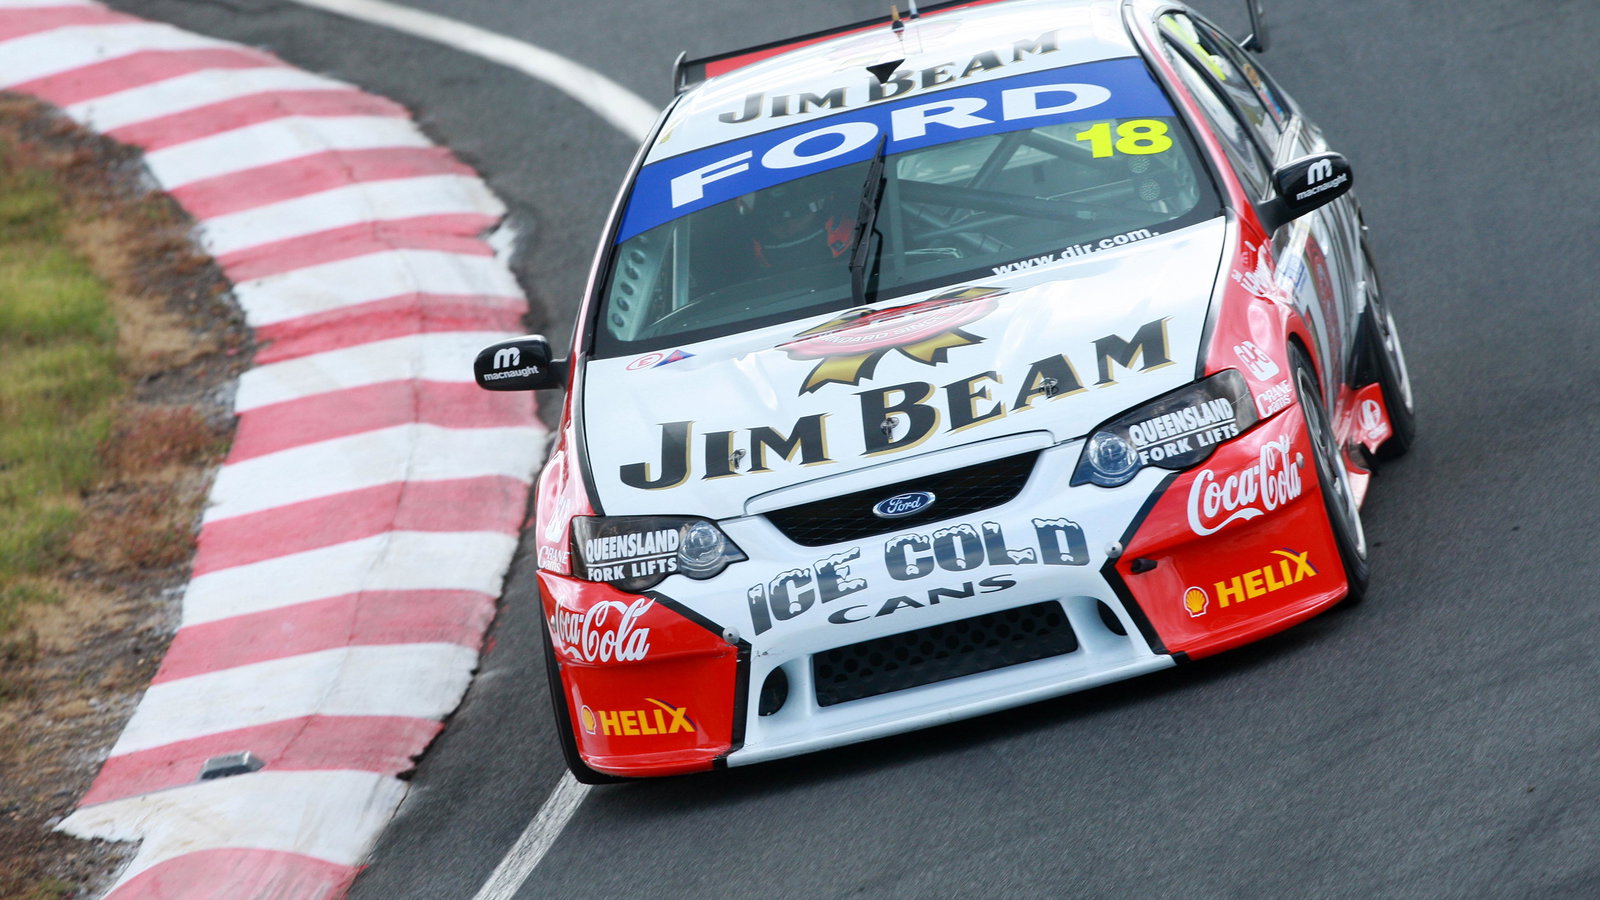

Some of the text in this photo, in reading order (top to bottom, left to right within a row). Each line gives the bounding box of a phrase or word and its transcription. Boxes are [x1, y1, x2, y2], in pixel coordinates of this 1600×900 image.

[718, 30, 1060, 124] JIM BEAM
[670, 83, 1112, 208] FORD
[1076, 119, 1173, 158] 18
[1296, 173, 1348, 200] macnaught
[483, 365, 540, 381] macnaught
[619, 315, 1176, 490] JIM BEAM
[1128, 397, 1235, 447] QUEENSLAND
[1139, 423, 1239, 466] FORK LIFTS
[887, 495, 921, 513] Ford
[1186, 434, 1303, 536] Coca-Cola
[585, 528, 680, 562] QUEENSLAND
[587, 557, 678, 582] FORK LIFTS
[747, 517, 1090, 636] ICE COLD
[1213, 547, 1319, 608] HELIX
[827, 573, 1017, 624] CANS
[599, 698, 699, 736] HELIX
